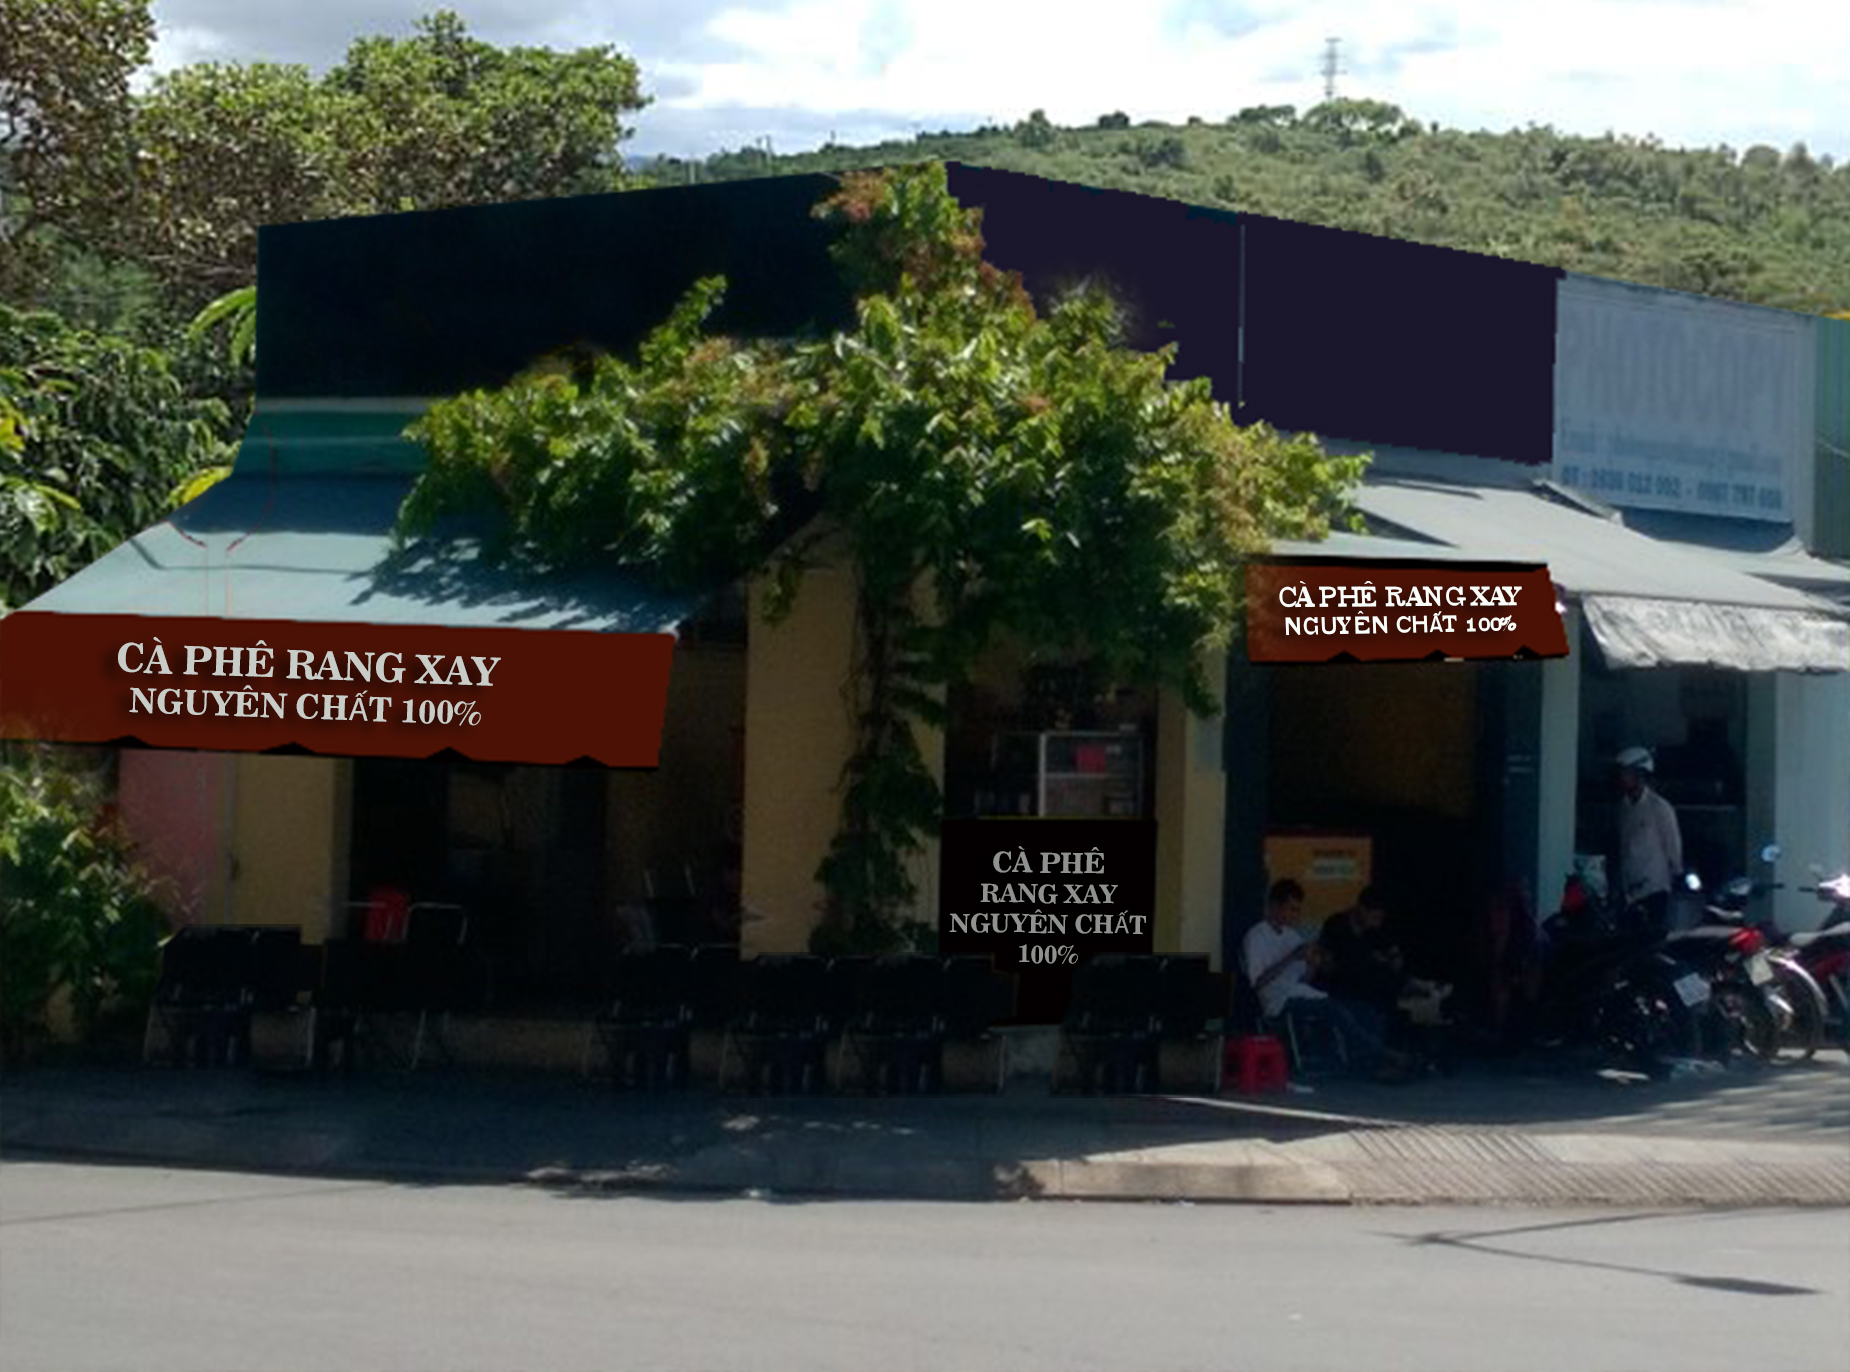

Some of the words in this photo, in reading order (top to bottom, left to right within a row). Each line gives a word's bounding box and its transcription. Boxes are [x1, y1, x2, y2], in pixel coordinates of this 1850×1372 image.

[1279, 581, 1315, 607] CÀ
[1319, 581, 1376, 607] PHÊ
[1385, 586, 1466, 607] RANG
[1470, 586, 1522, 606] XAY
[1285, 611, 1388, 635] NGUYÊN
[1397, 611, 1457, 633] CHẤT
[1467, 615, 1517, 632] 100%
[117, 637, 173, 675] CÀ
[183, 640, 274, 677] PHÊ
[286, 649, 406, 683] RANG
[414, 654, 501, 687] XAY
[129, 685, 288, 719] NGUYÊN
[296, 690, 392, 723] CHẤT
[402, 699, 482, 727] 100%
[993, 846, 1033, 873] CÀ
[1040, 847, 1105, 874] PHÊ
[981, 883, 1058, 904] RANG
[1063, 884, 1118, 904] XAY
[949, 909, 1068, 934] NGUYÊN
[1075, 910, 1147, 935] CHẤT
[1018, 944, 1078, 964] 100%
